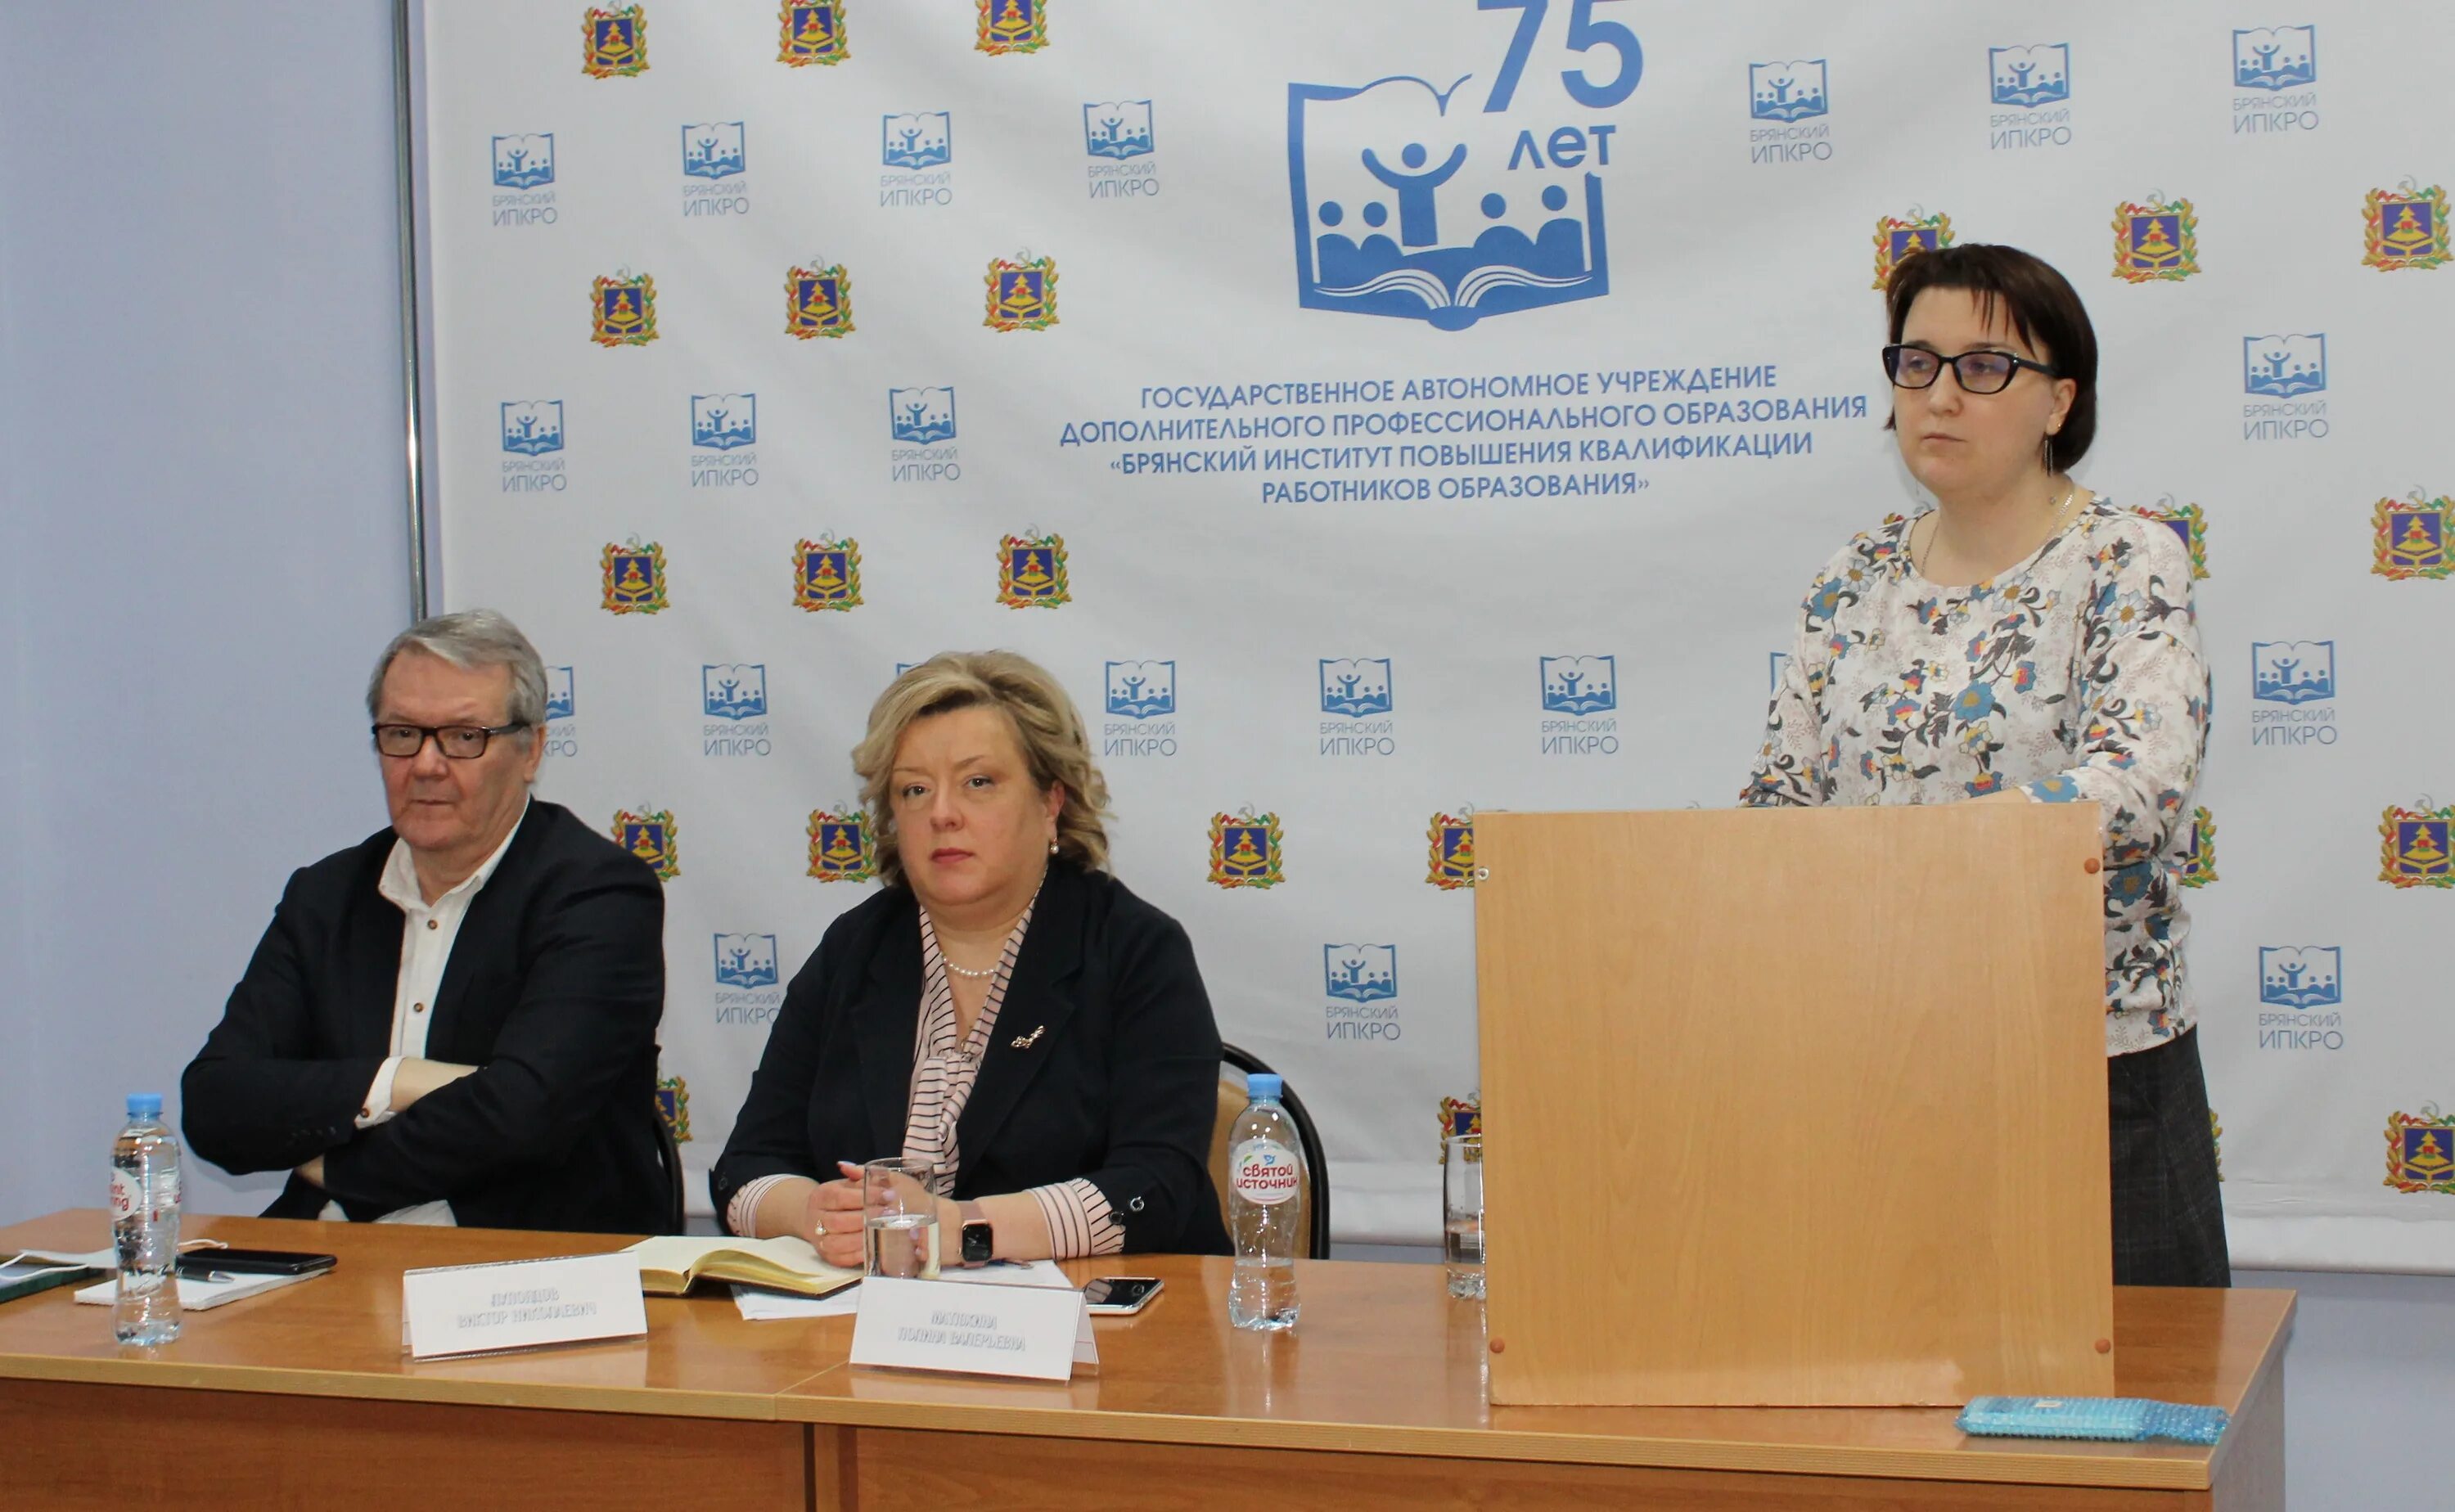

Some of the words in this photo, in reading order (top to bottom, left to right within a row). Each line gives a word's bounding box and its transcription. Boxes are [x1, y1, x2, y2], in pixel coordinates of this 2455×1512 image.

[1477, 0, 1643, 113] 75
[2232, 92, 2317, 111] БРЯНСКИЙ
[1990, 108, 2070, 128] БРЯНСКИЙ
[2233, 110, 2319, 133] ИПКРО
[1750, 123, 1830, 142] БРЯНСКИЙ
[1991, 126, 2072, 150] ИПКРО
[1751, 142, 1832, 164] ИПКРО
[1088, 160, 1156, 178] БРЯНСКИЙ
[682, 181, 746, 196] БРЯНСКИЙ
[881, 171, 950, 187] БРЯНСКИЙ
[1089, 178, 1160, 198] ИПКРО
[493, 191, 555, 206] БРЯНСКИЙ
[683, 197, 750, 216] ИПКРО
[880, 187, 953, 207] ИПКРО
[493, 207, 557, 226] ИПКРО
[1142, 380, 1394, 411] ГОСУДАРСТВЕННОЕ
[1402, 373, 1588, 401] АВТОНОМНОЕ
[1597, 365, 1776, 394] УЧРЕЖДЕНИЕ
[2244, 399, 2327, 418] БРЯНСКИЙ
[1060, 416, 1325, 447] ДОПОЛНИТЕЛЬНОГО
[1333, 404, 1655, 436] ПРОФЕССИОНАЛЬНОГО
[1664, 395, 1867, 425] ОБРАЗОВАНИЯ
[2244, 419, 2329, 440] ИПКРО
[691, 452, 757, 466] БРЯНСКИЙ
[892, 446, 957, 461] БРЯНСКИЙ
[1110, 445, 1256, 474] «БРЯНСКИЙ
[1264, 447, 1393, 470] ИНСТИТУТ
[1400, 441, 1570, 466] ПОВЫШЕНИЯ
[1580, 432, 1812, 461] КВАЛИФИКАЦИИ
[502, 457, 565, 472] БРЯНСКИЙ
[893, 463, 961, 481] ИПКРО
[502, 474, 567, 493] ИПКРО
[692, 468, 759, 487] ИПКРО
[1263, 479, 1430, 503] РАБОТНИКОВ
[1438, 472, 1649, 499] ОБРАЗОВАНИЯ»
[2252, 707, 2336, 723] БРЯНСКИЙ
[704, 722, 769, 736] БРЯНСКИЙ
[1104, 722, 1175, 736] БРЯНСКИЙ
[1320, 720, 1393, 735] БРЯНСКИЙ
[1542, 718, 1616, 733] БРЯНСКИЙ
[1543, 736, 1619, 754] ИПКРО
[2253, 726, 2337, 745] ИПКРО
[704, 739, 772, 756] ИПКРО
[1105, 738, 1177, 757] ИПКРО
[1321, 737, 1395, 755] ИПКРО
[715, 992, 780, 1005] БРЯНСКИЙ
[1326, 1006, 1399, 1019] БРЯНСКИЙ
[2259, 1012, 2340, 1026] БРЯНСКИЙ
[1327, 1022, 1400, 1040] ИПКРО
[2259, 1030, 2344, 1050] ИПКРО
